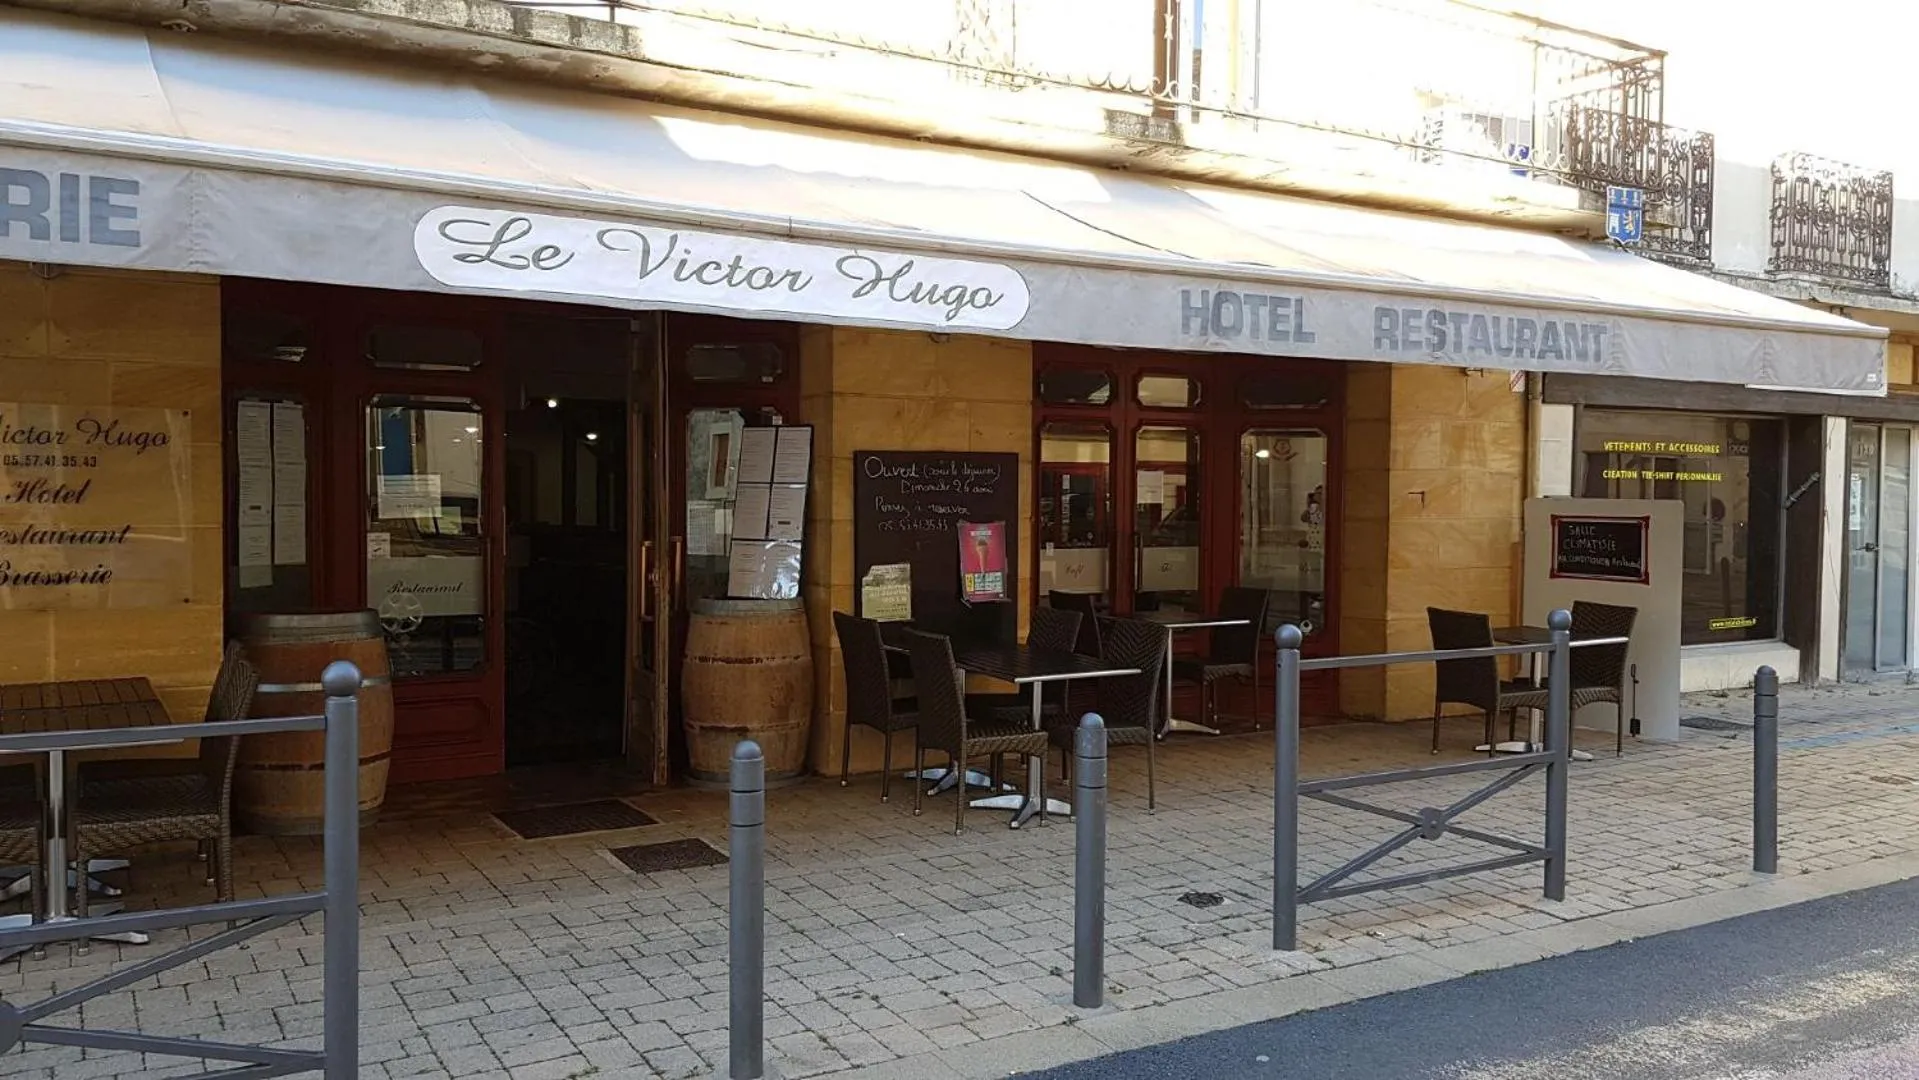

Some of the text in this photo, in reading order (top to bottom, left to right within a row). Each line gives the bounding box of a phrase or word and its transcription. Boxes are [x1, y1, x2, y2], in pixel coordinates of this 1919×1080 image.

[0, 167, 141, 247] RIE
[438, 217, 1004, 322] Le Victor Hugo
[1180, 289, 1608, 363] HOTEL RESTAURANT
[0, 414, 169, 454] ictor Hugo
